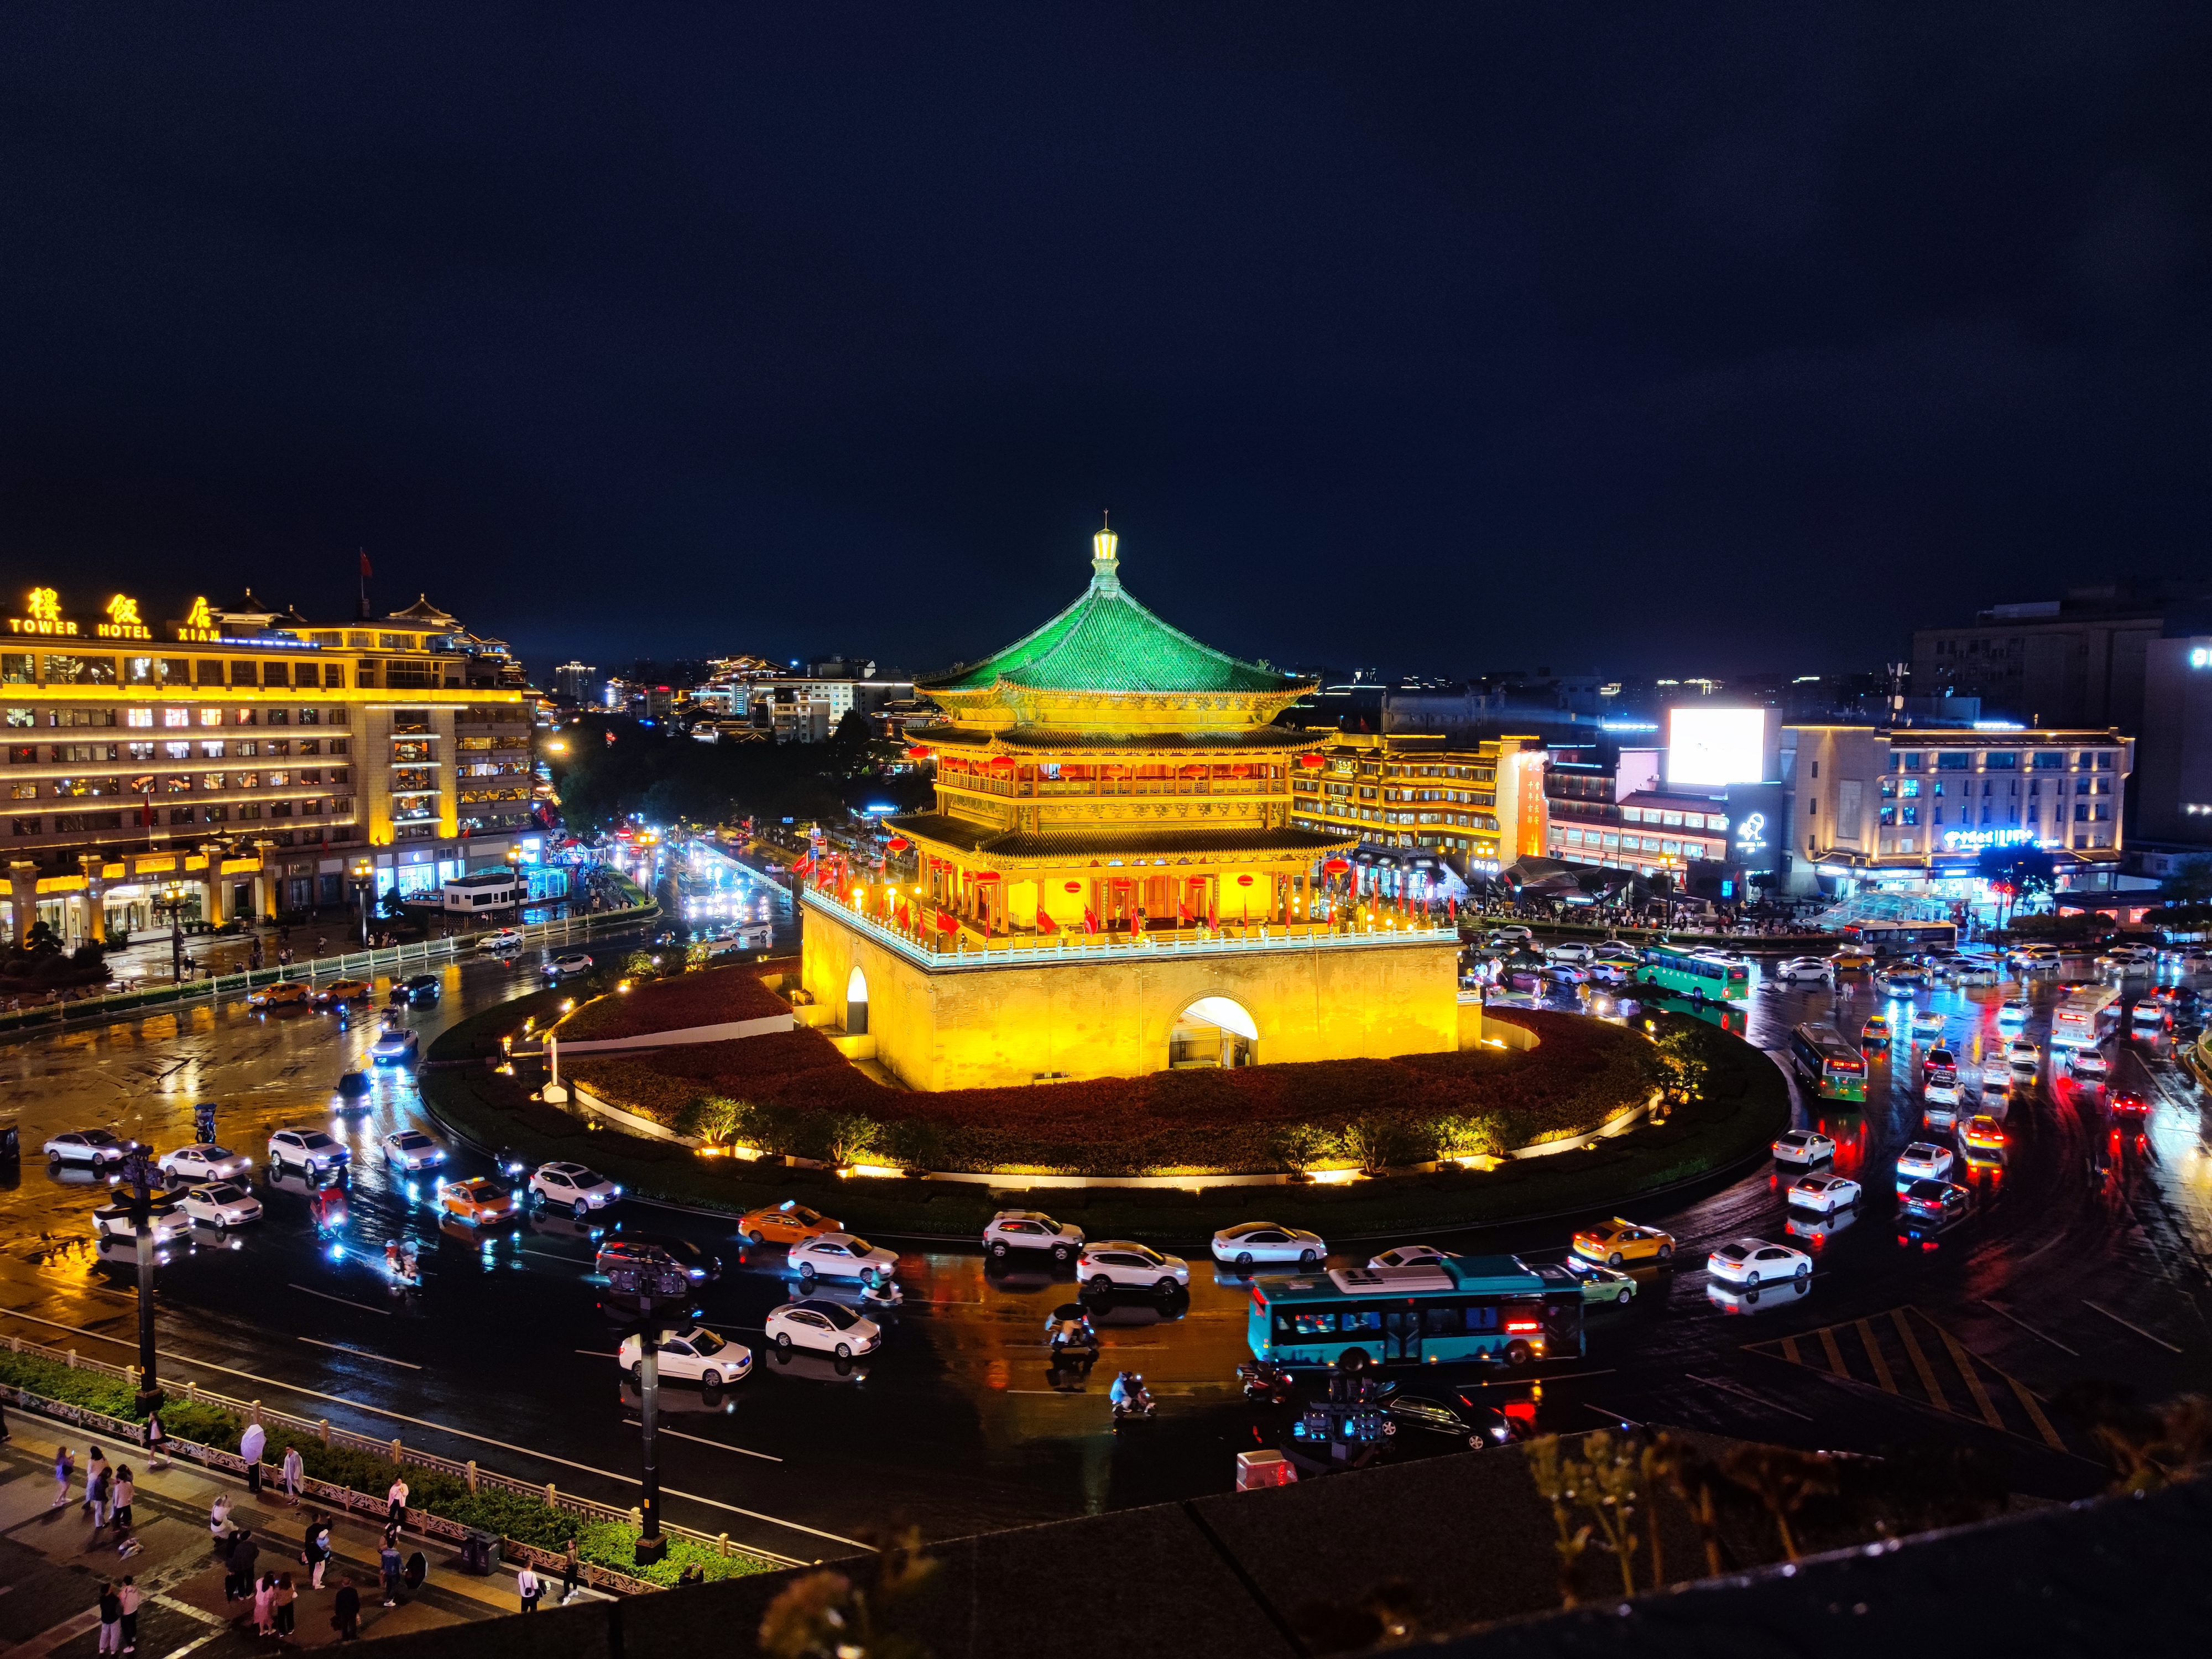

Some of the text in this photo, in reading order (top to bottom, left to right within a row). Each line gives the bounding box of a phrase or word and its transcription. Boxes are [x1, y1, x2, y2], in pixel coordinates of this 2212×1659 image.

[9, 618, 220, 641] TOWER HOTEL XIAN
